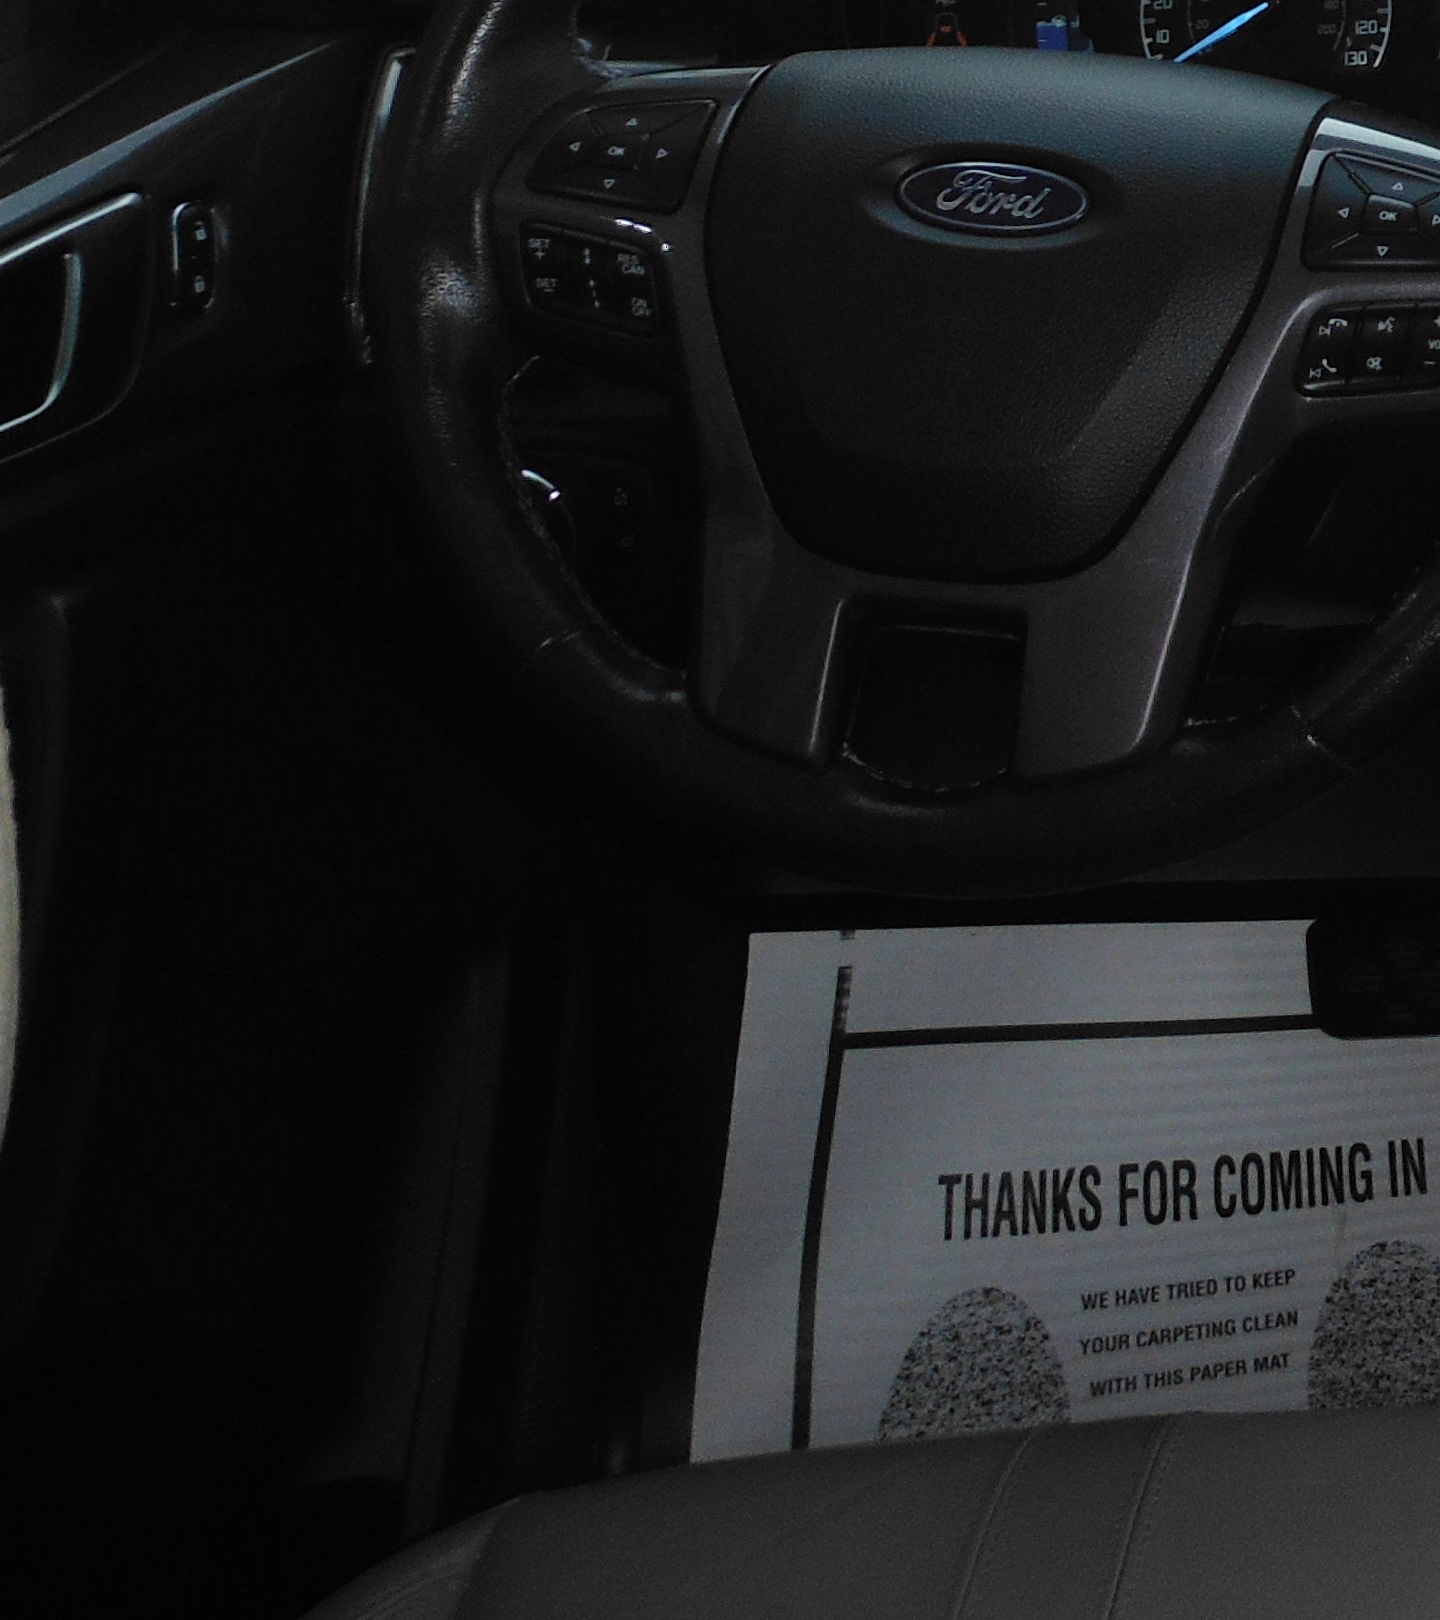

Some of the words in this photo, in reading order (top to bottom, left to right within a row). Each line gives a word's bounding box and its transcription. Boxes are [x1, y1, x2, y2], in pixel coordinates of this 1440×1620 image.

[1156, 30, 1170, 44] 10
[1355, 19, 1379, 35] 120
[1344, 50, 1368, 66] 130
[607, 145, 626, 156] OK
[935, 168, 1053, 221] Ford
[1379, 210, 1399, 222] OK
[938, 1164, 1102, 1241] THANKS
[1118, 1157, 1199, 1227] FOR
[1213, 1141, 1375, 1219] COMING
[1387, 1137, 1429, 1199] IN
[1080, 1291, 1109, 1310] WE
[1115, 1285, 1161, 1307] HAVE
[1165, 1278, 1218, 1300] TRIED
[1224, 1274, 1247, 1293] TO
[1252, 1268, 1296, 1290] KEEP
[1079, 1333, 1130, 1356] YOUR
[1135, 1318, 1237, 1348] CARPETING
[1242, 1309, 1299, 1333] CLEAN
[1090, 1374, 1138, 1398] WITH
[1143, 1368, 1184, 1390] THIS
[1189, 1358, 1248, 1383] PAPER
[1253, 1352, 1290, 1373] MAT
